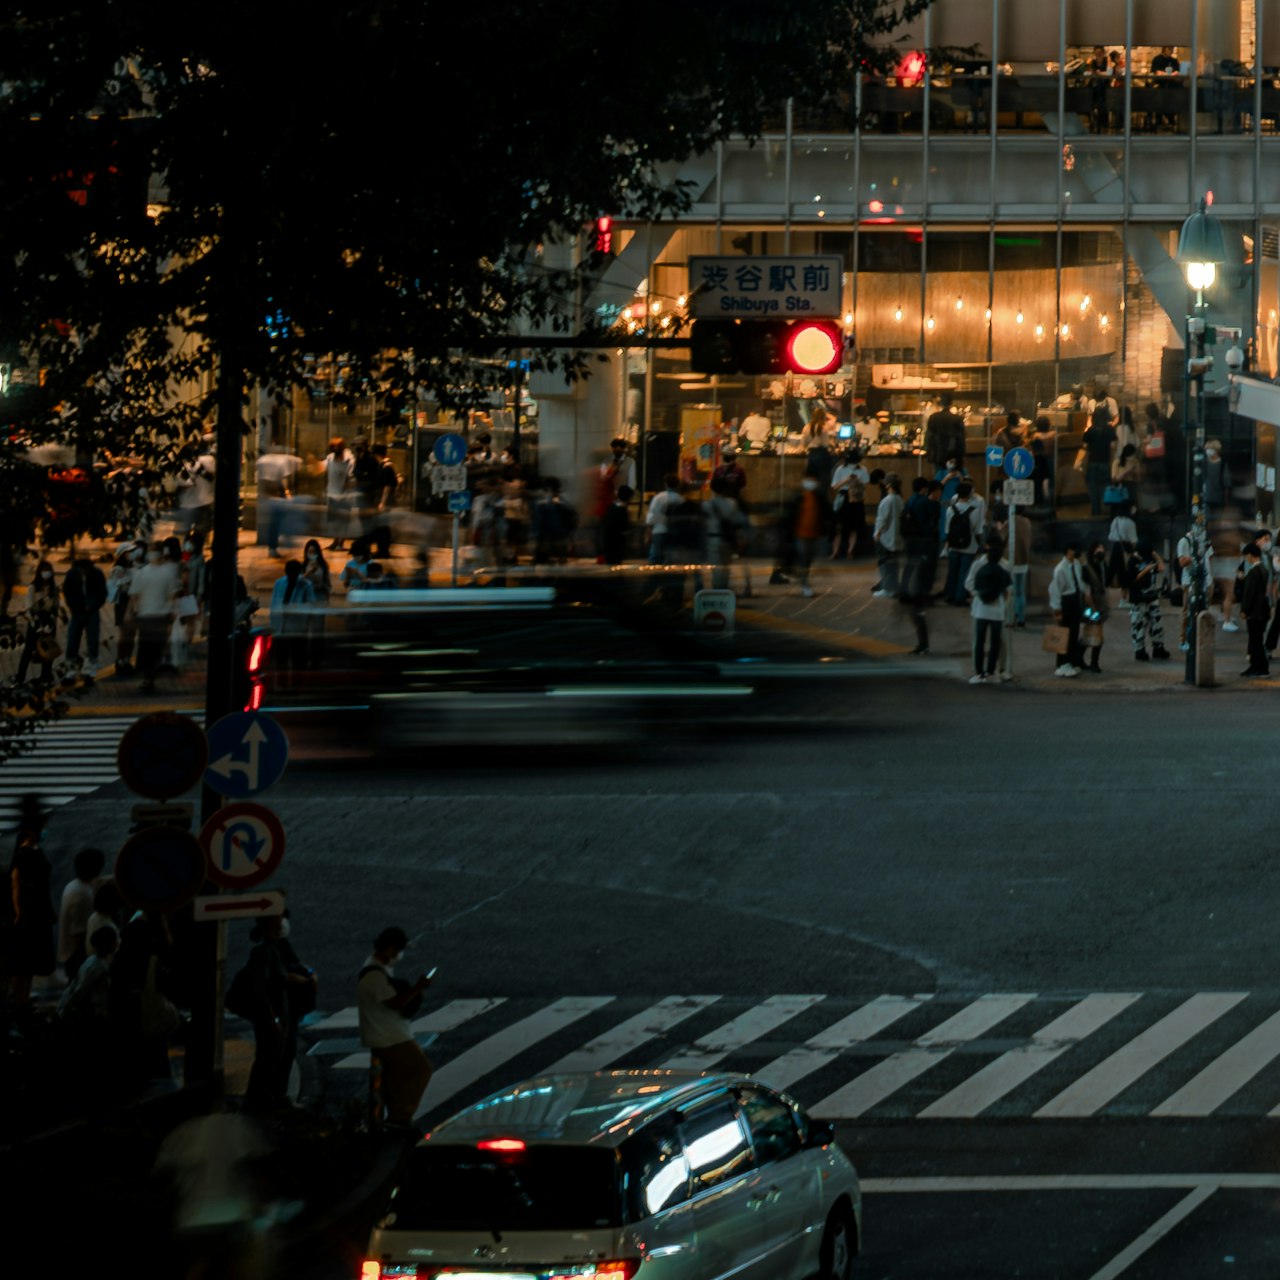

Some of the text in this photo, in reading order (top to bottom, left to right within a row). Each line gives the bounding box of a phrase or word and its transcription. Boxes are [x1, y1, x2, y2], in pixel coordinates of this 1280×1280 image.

[702, 265, 831, 292] 渋谷駅前
[720, 295, 816, 313] Shibuya Sta.
